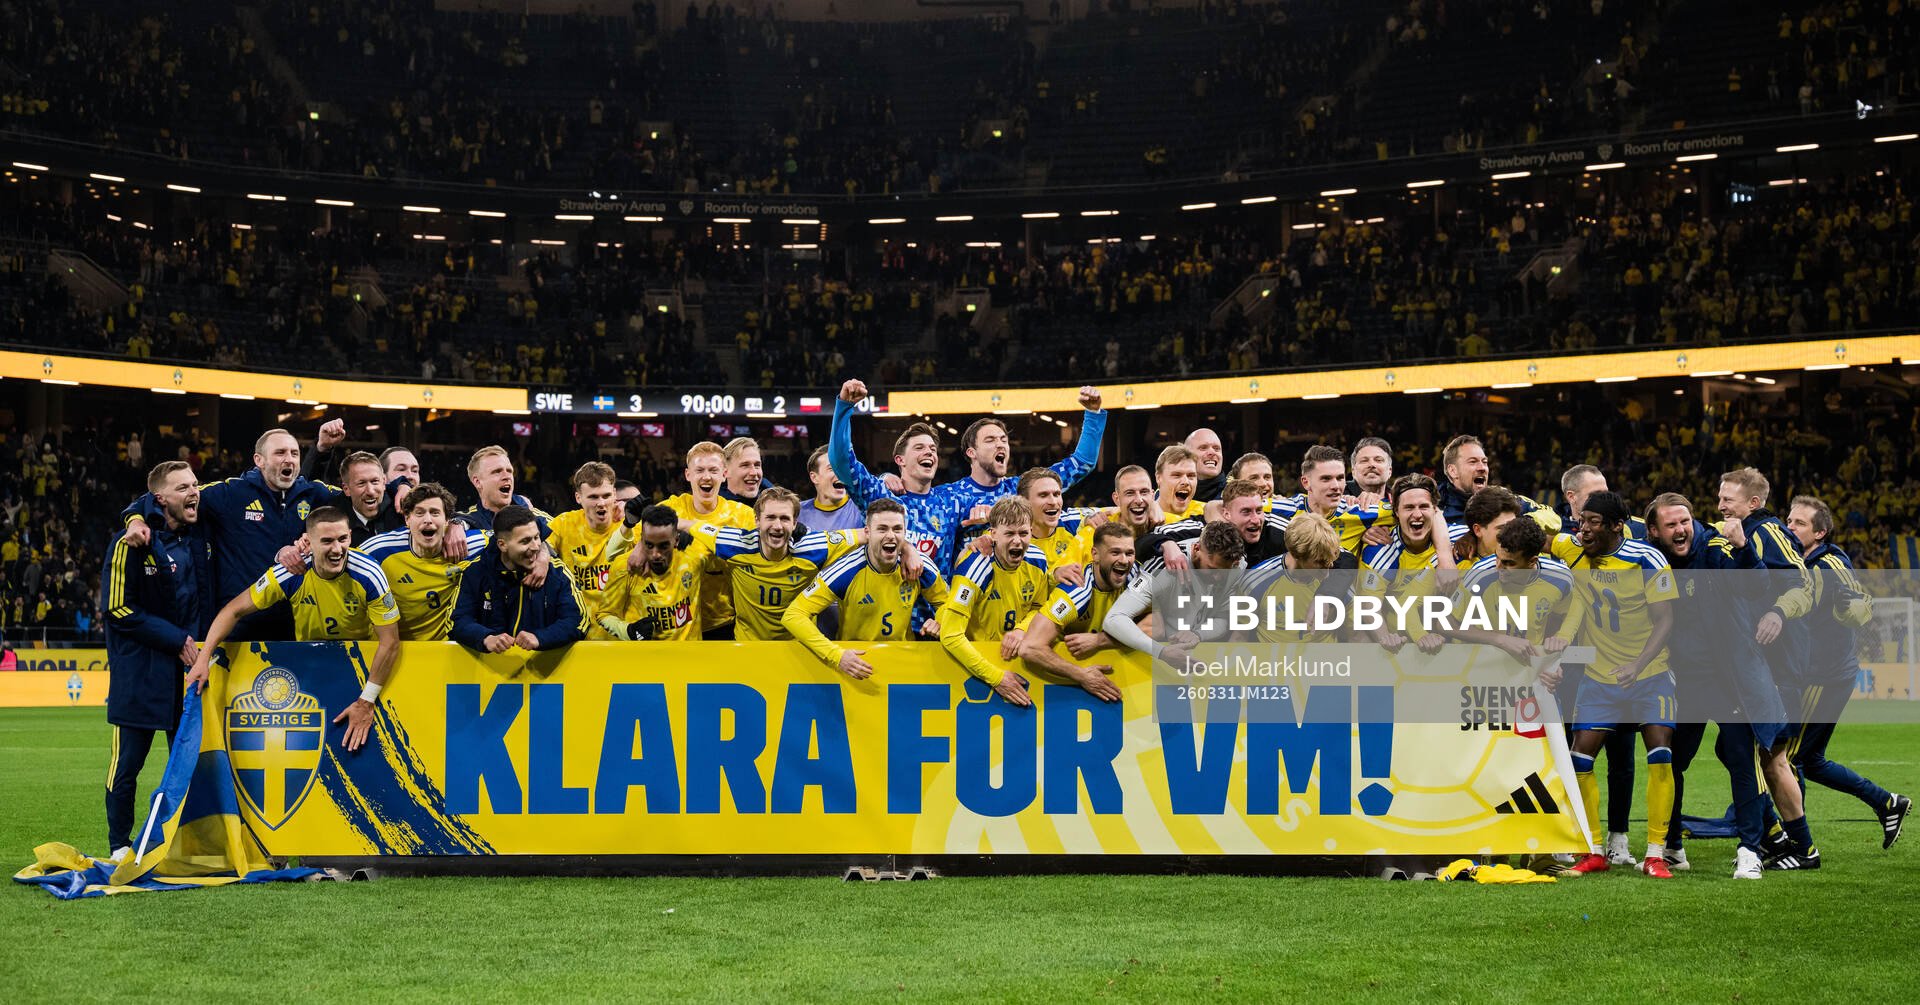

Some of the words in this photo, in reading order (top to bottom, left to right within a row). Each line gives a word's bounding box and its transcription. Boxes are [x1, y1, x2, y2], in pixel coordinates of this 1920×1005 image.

[1624, 142, 1660, 155] Room
[1663, 139, 1680, 152] for
[1683, 135, 1744, 150] emotions
[1480, 152, 1546, 170] Strawberry
[1549, 149, 1585, 162] Arena
[559, 200, 626, 213] Strawberry
[630, 201, 666, 212] Arena
[704, 202, 740, 214] Room
[742, 203, 759, 214] for
[762, 203, 818, 215] emotions
[535, 393, 573, 410] SWE
[629, 394, 642, 412] 3
[680, 394, 735, 413] 90:00
[773, 395, 786, 413] 2
[854, 395, 880, 412] OL
[573, 564, 611, 580] SVENSK
[426, 591, 441, 609] 3
[759, 585, 782, 606] 10
[1587, 582, 1620, 632] 11
[325, 617, 339, 635] 2
[653, 620, 677, 632] PEL
[881, 611, 893, 636] 5
[1003, 610, 1016, 632] 8
[1460, 685, 1535, 708] SVENS
[1657, 695, 1674, 721] 11
[239, 714, 311, 725] SVERIGE
[1460, 709, 1512, 731] SPEL
[444, 683, 857, 815] KLARA
[887, 675, 1124, 817] FÖR
[1156, 685, 1394, 816] VM!
